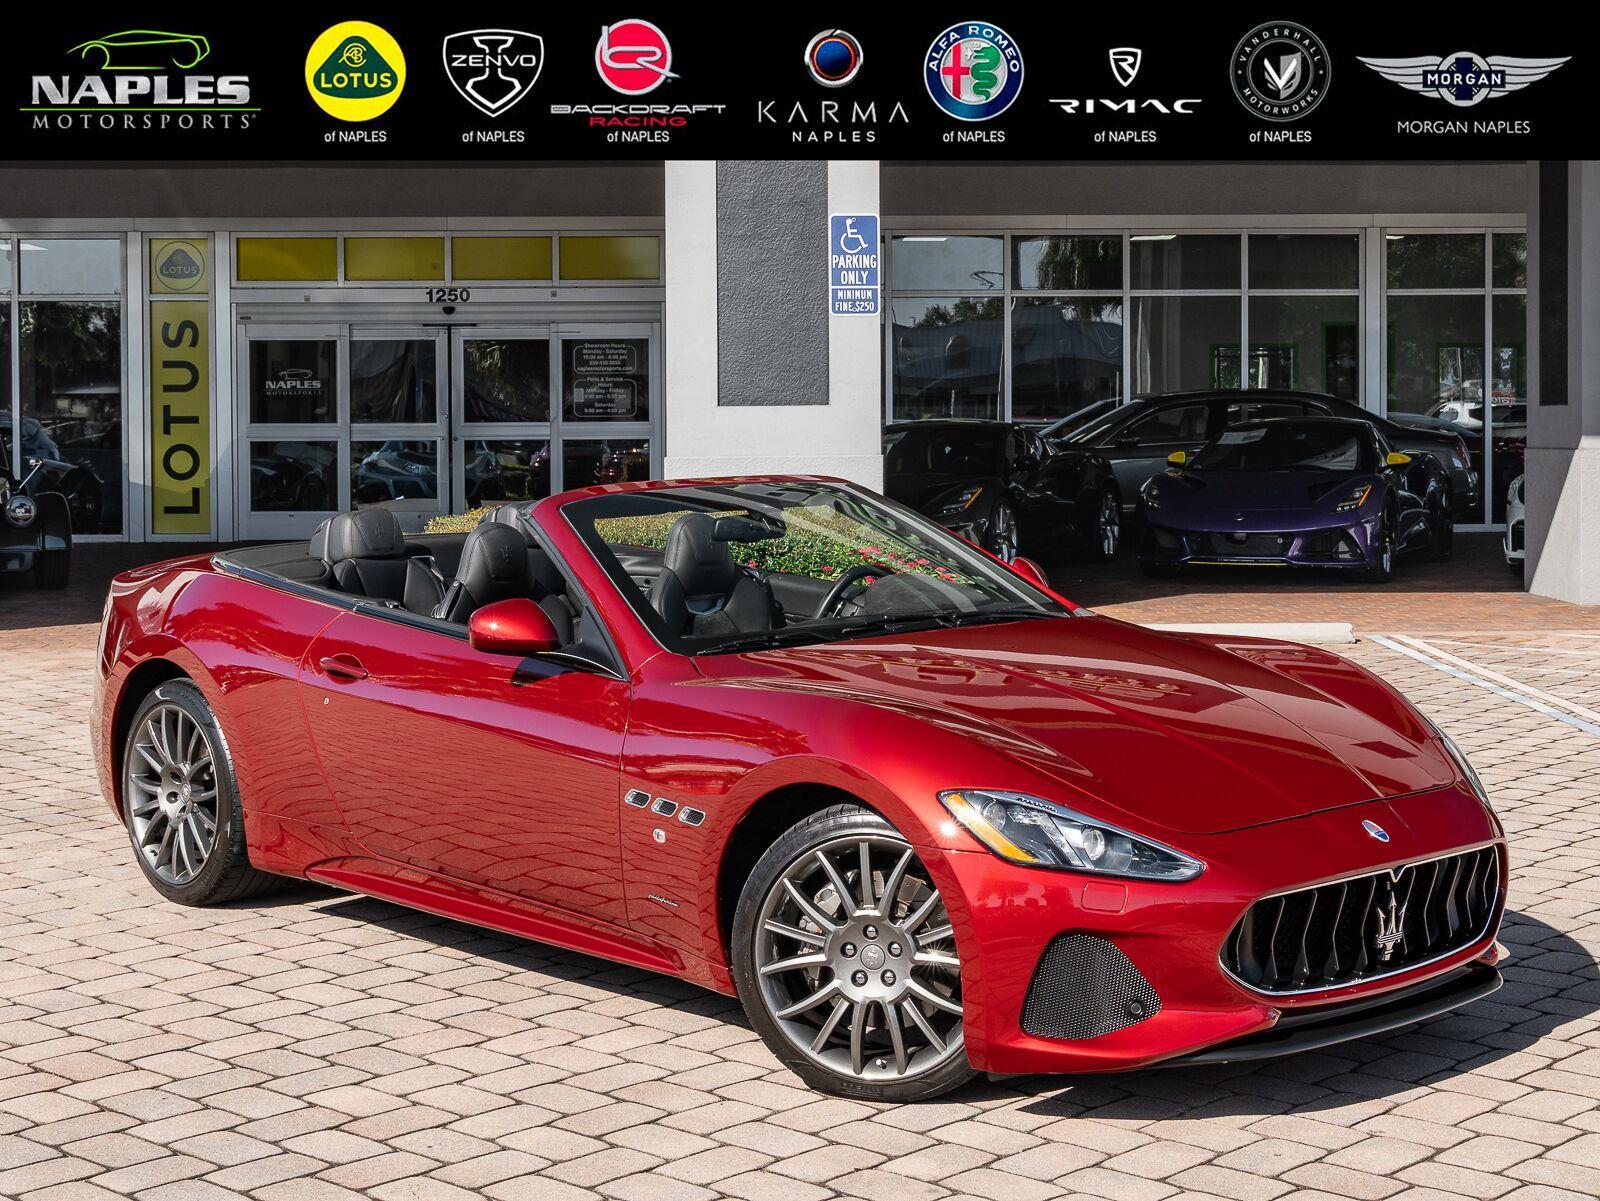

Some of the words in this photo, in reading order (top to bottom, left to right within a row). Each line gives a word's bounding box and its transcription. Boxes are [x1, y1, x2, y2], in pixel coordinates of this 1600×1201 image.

[832, 254, 877, 269] PARKING
[163, 266, 198, 274] LOTUS
[840, 270, 869, 285] ONLY
[425, 289, 471, 302] 1250
[837, 289, 873, 300] MINIMUM
[835, 301, 852, 312] FINE
[855, 301, 875, 312] $250
[265, 380, 321, 389] NAPLES
[161, 319, 200, 515] LOTUS
